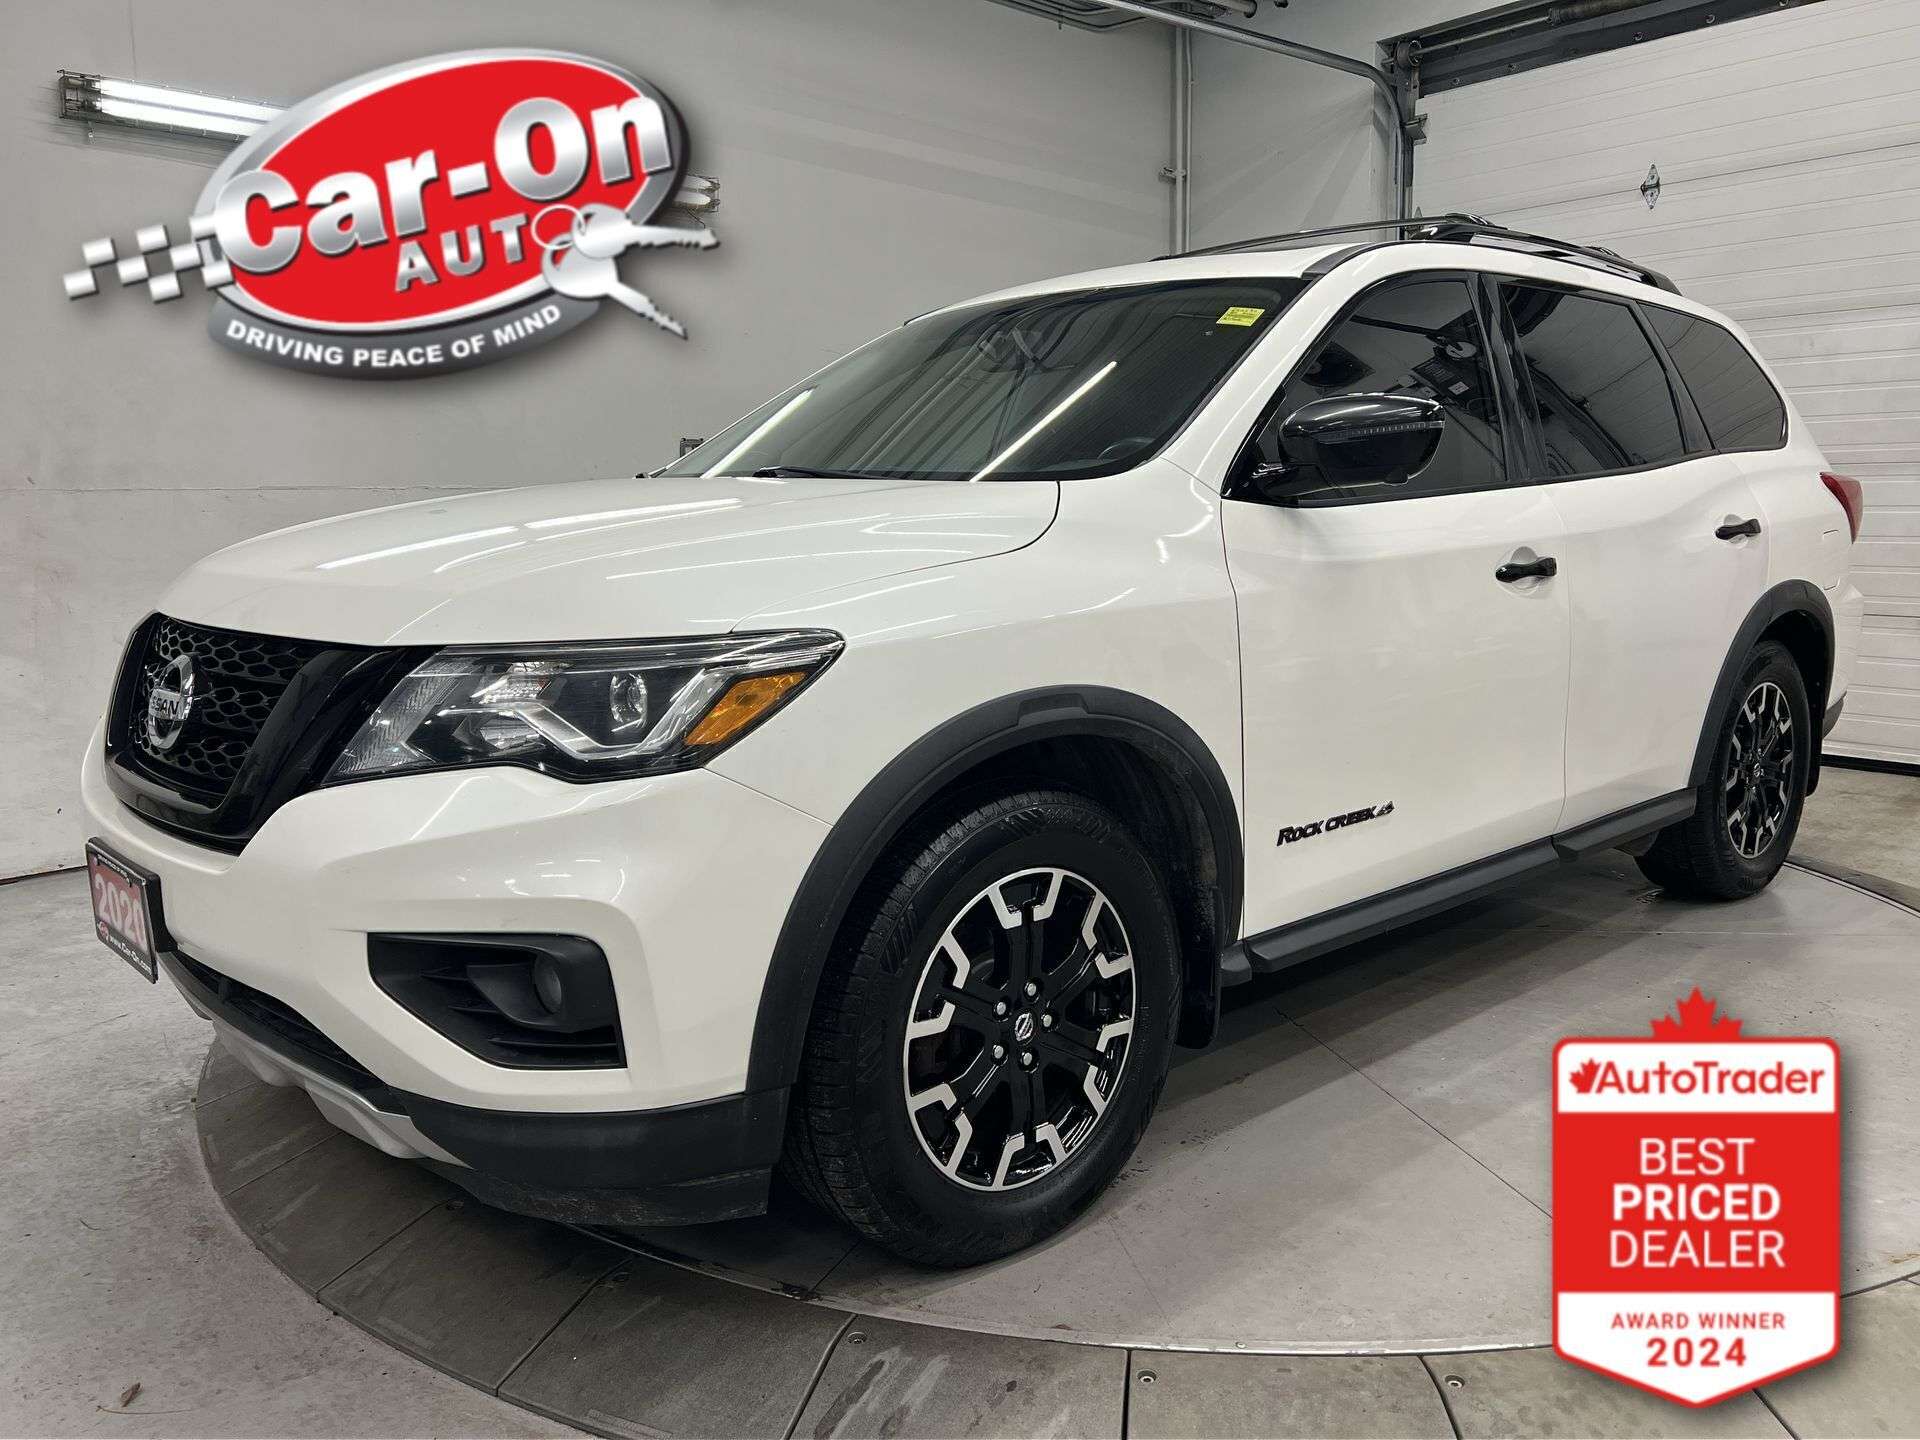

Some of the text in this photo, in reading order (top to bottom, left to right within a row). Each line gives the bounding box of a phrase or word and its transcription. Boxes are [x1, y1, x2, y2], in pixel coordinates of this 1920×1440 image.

[1276, 805, 1377, 847] ROCK CREEK
[95, 872, 149, 954] 2020
